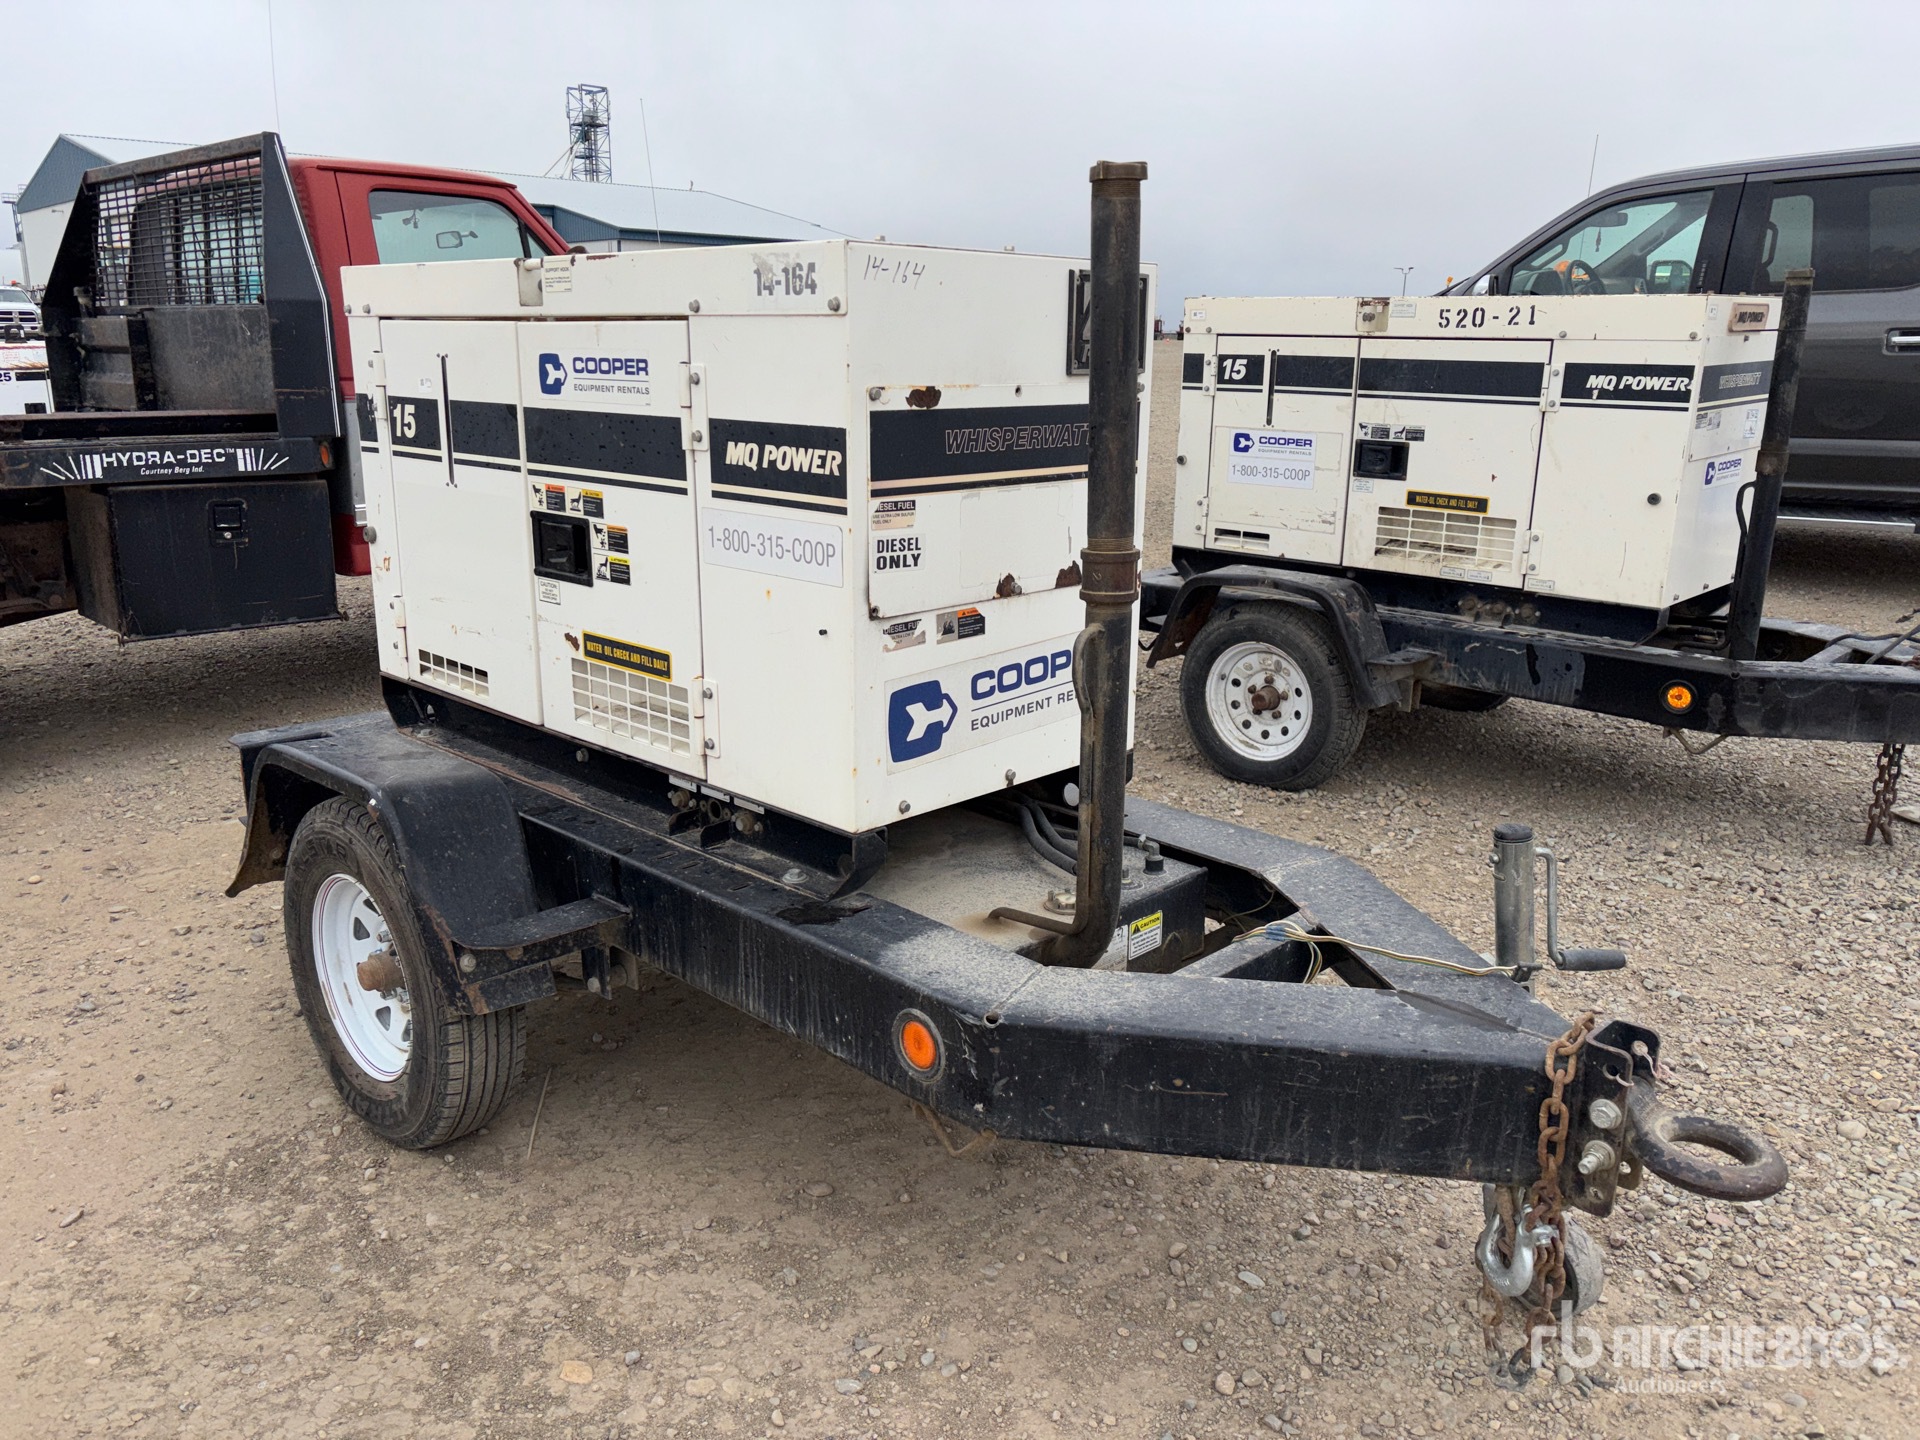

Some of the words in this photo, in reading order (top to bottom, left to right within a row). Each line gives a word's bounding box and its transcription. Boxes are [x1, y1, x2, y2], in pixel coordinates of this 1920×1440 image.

[753, 262, 817, 296] 14-164
[863, 254, 926, 290] 14-164
[572, 356, 649, 376] COOPER
[1222, 358, 1248, 380] 15
[0, 371, 12, 382] 5
[1585, 374, 1617, 391] MQ
[1618, 375, 1690, 391] POWER
[573, 383, 615, 394] EQUIPMENT
[617, 385, 650, 396] RENTALS
[393, 403, 416, 439] 15
[1258, 436, 1313, 448] COOPER
[725, 441, 760, 472] MQ
[762, 444, 843, 477] POWER
[1717, 458, 1743, 472] COOPER
[140, 466, 172, 476] Courtney
[174, 465, 190, 475] Berg
[192, 465, 205, 473] Ind.
[1231, 464, 1311, 482] 1-800-315-COOP
[897, 501, 915, 510] FUEL
[708, 525, 836, 568] 1-800-315-COOP
[876, 537, 922, 554] DIESEL
[876, 553, 922, 571] ONLY
[613, 648, 630, 661] CHECK
[630, 653, 641, 664] AND
[641, 655, 653, 668] FILL
[653, 658, 668, 671] DAILY
[971, 649, 1072, 701] COOP
[971, 696, 1053, 732] EQUIPMENT
[1057, 690, 1078, 705] RE
[1140, 916, 1160, 929] CAUTION
